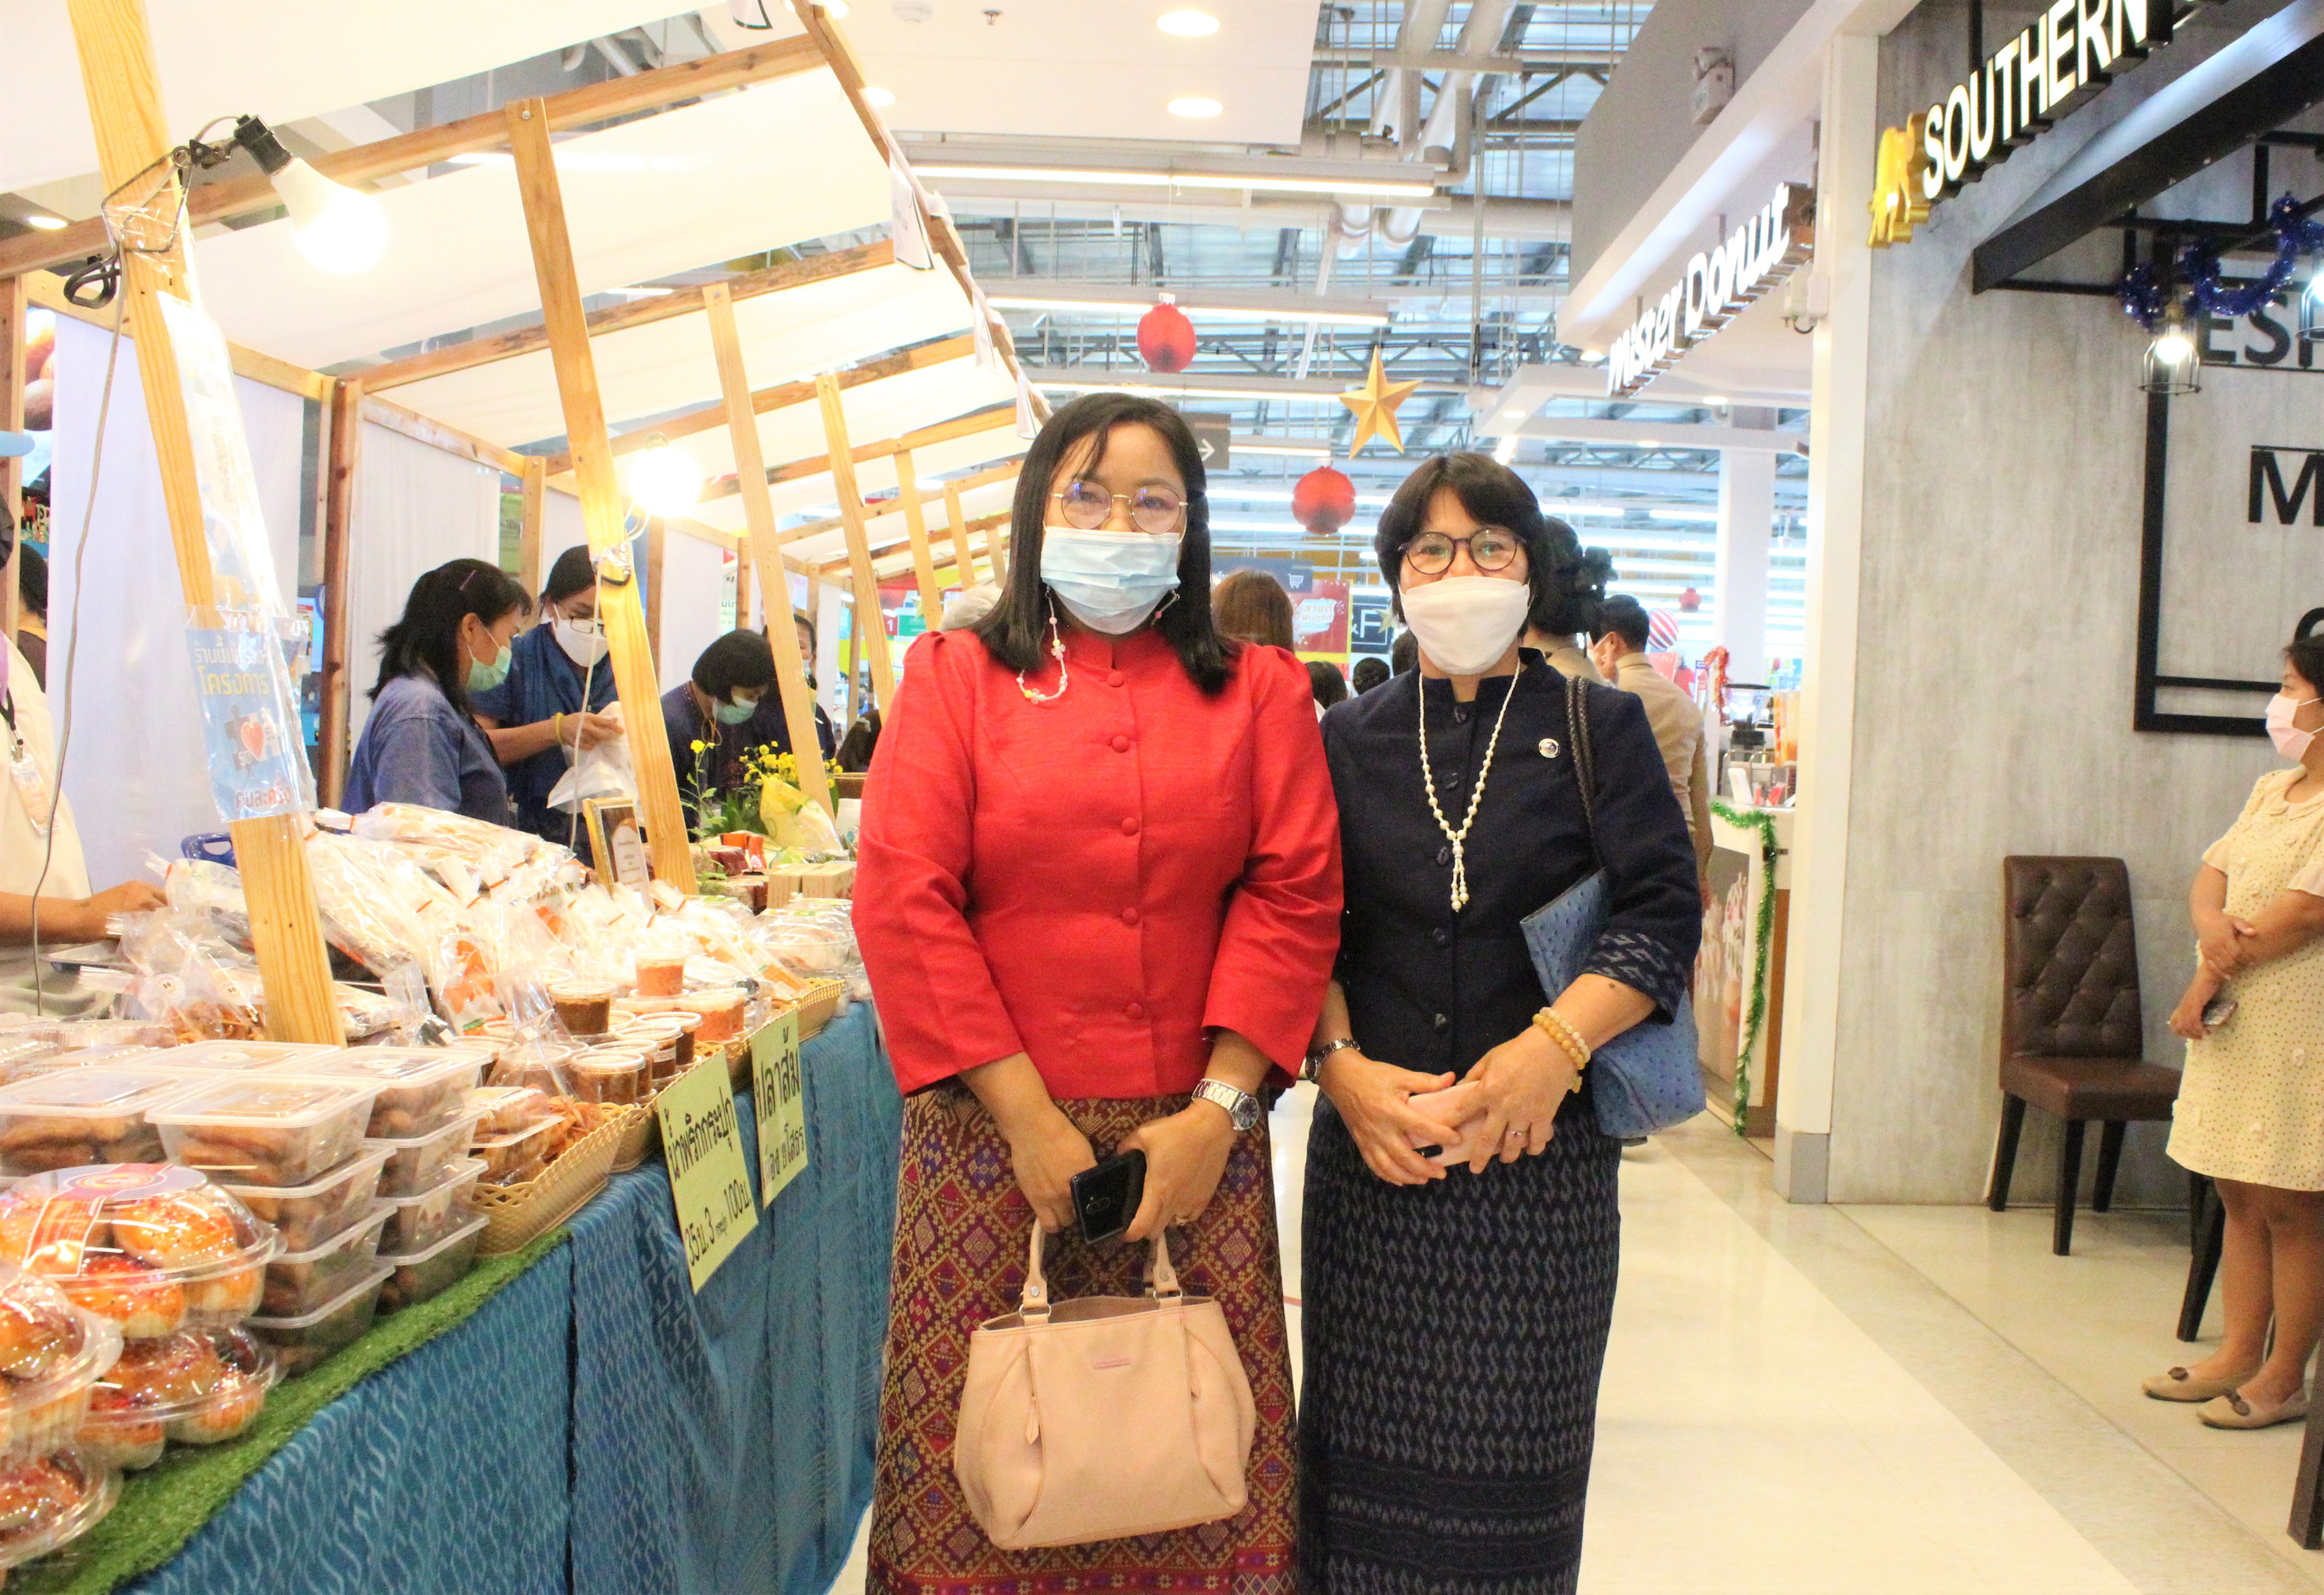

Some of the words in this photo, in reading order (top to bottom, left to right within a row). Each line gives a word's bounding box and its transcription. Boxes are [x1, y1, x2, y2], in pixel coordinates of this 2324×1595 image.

[1922, 0, 2148, 200] SOUTHERN
[197, 664, 270, 696] โครงการ
[755, 1025, 801, 1123] ปลาส้ม
[664, 1086, 736, 1182] น้ำพริกกระปุก
